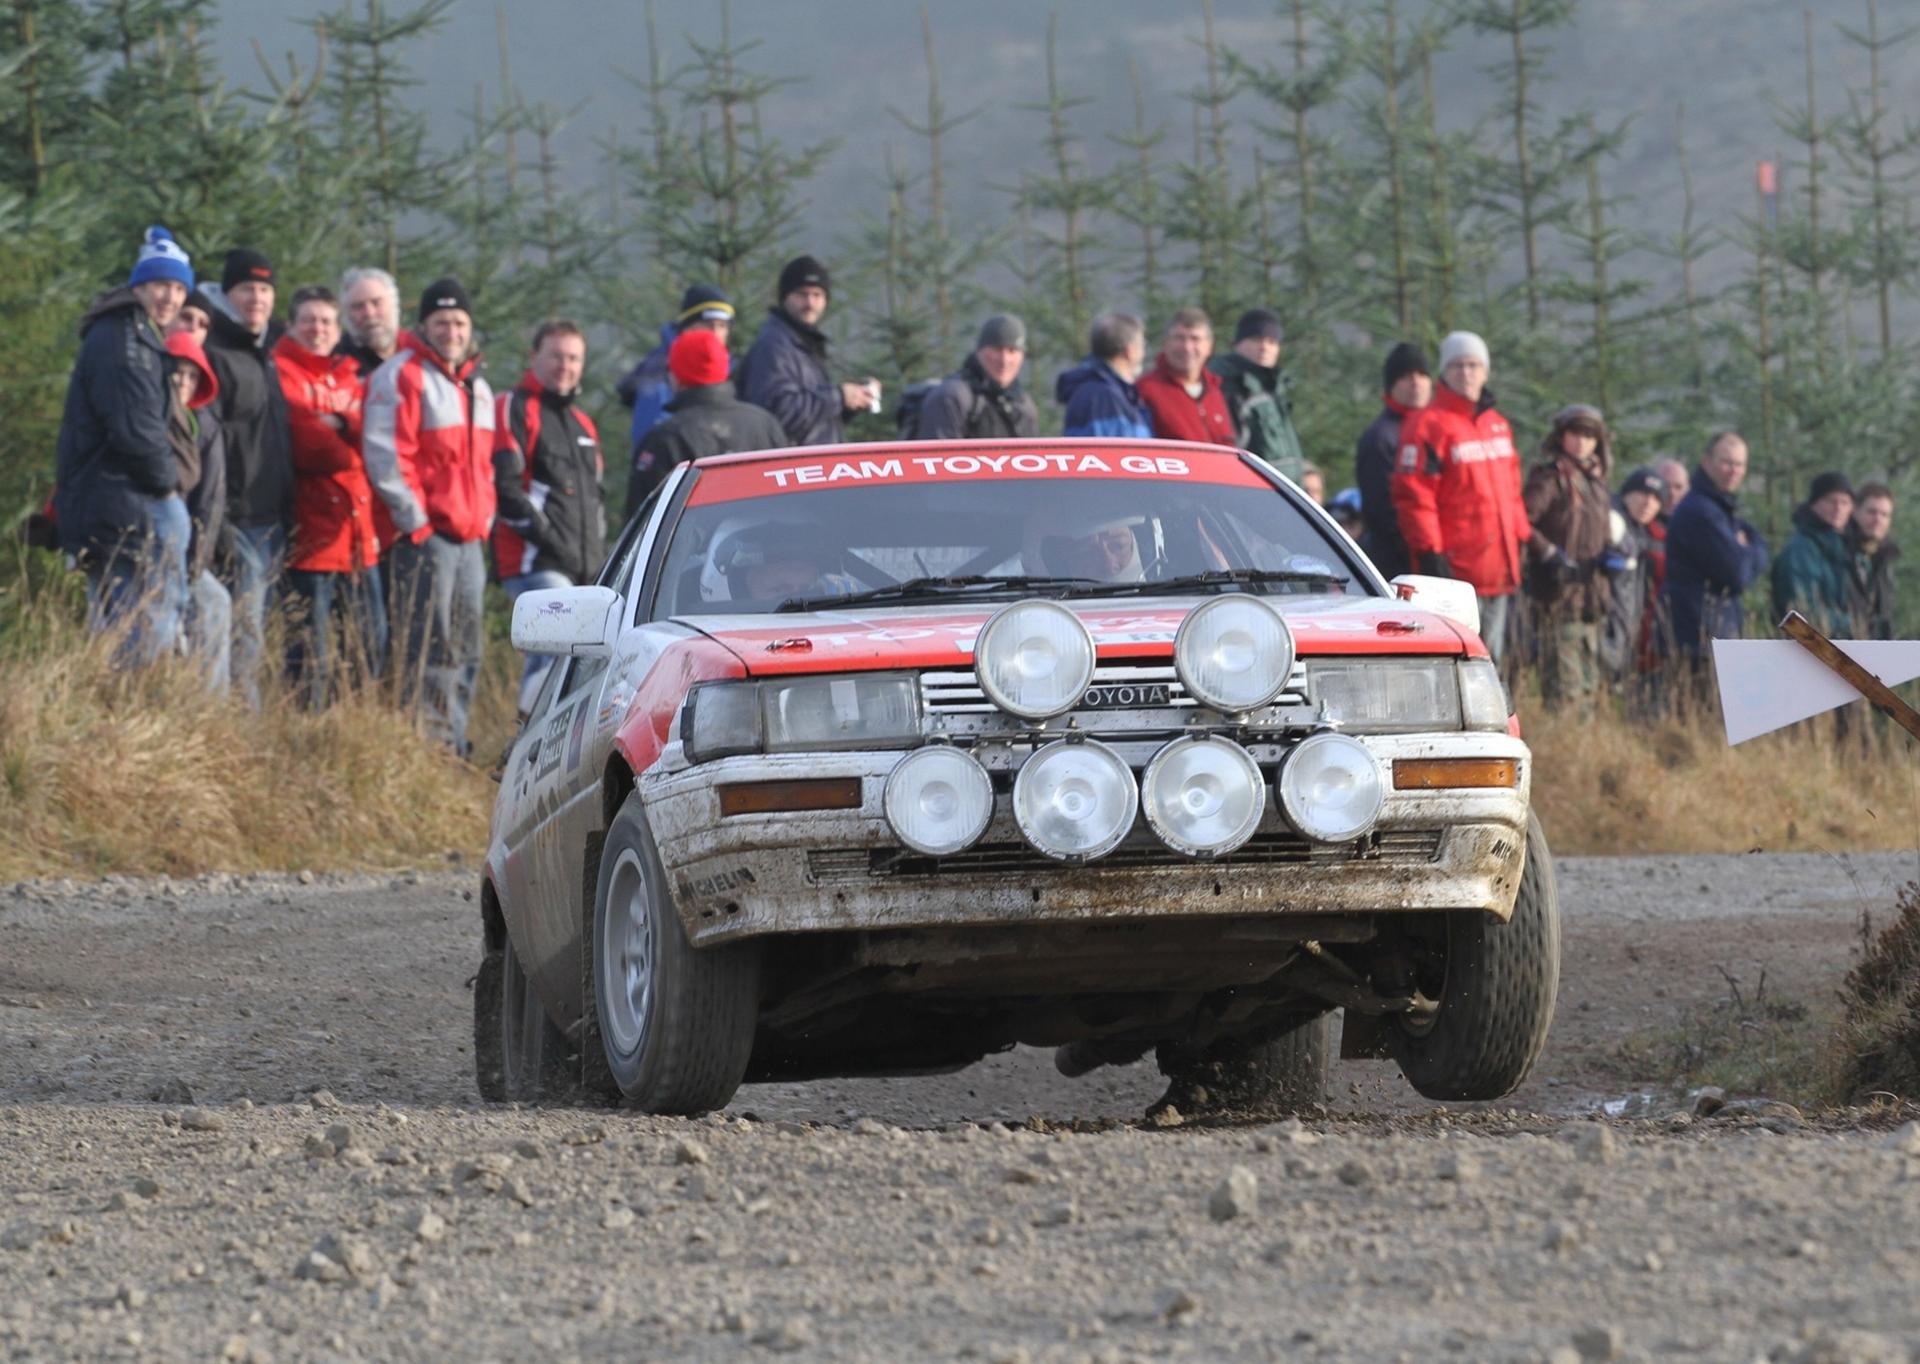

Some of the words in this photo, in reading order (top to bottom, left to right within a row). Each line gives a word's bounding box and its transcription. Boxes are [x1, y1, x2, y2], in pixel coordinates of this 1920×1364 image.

[763, 460, 904, 487] TEAM
[912, 454, 1112, 474] TOYOTA
[1120, 457, 1190, 476] GB
